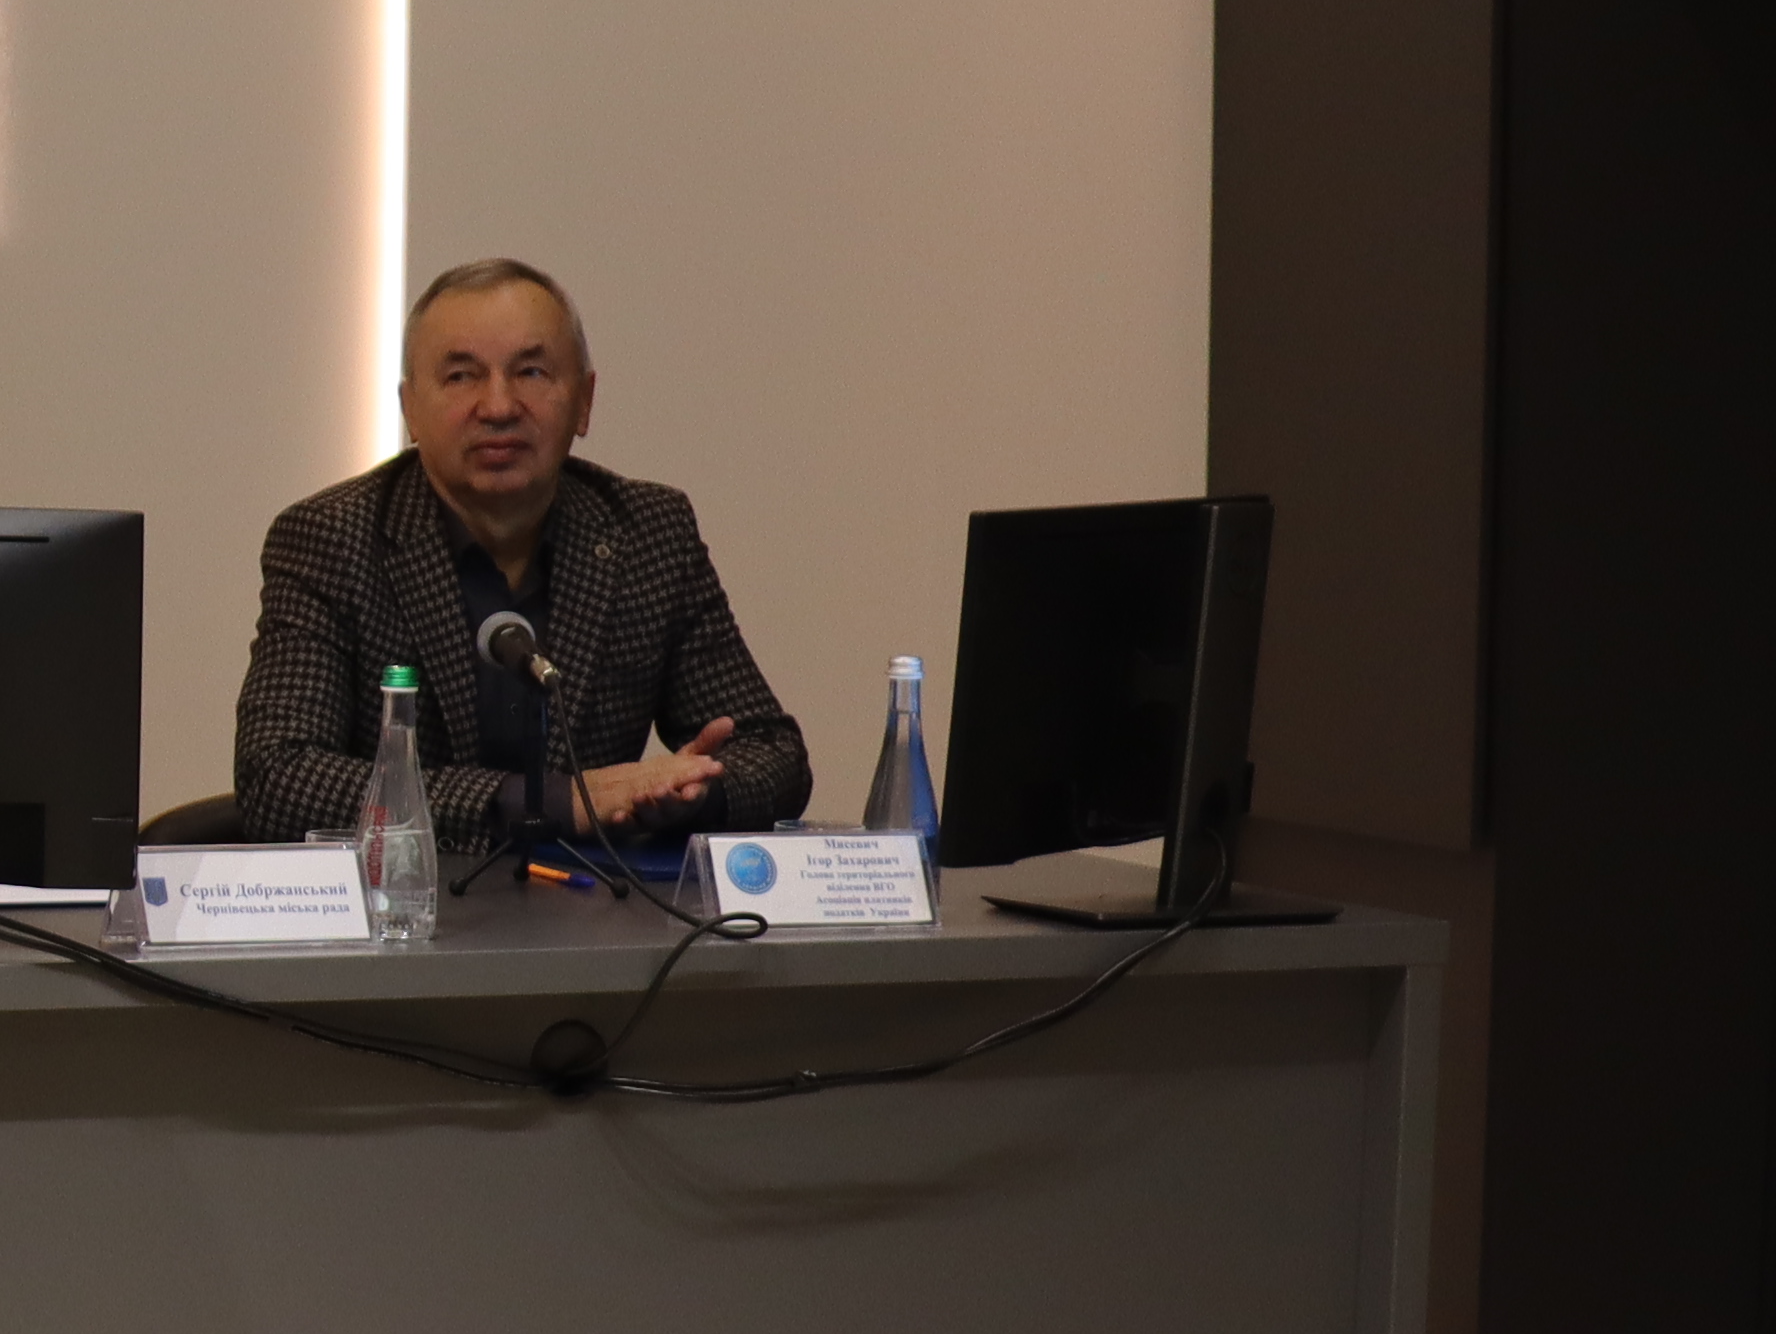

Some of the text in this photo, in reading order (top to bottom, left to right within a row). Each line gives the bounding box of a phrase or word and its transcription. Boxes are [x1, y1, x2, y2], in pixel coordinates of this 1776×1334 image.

[806, 854, 900, 868] Ігор Захарович
[179, 882, 348, 901] Сергій Добржанський
[196, 902, 351, 917] Чернівецька міська рада
